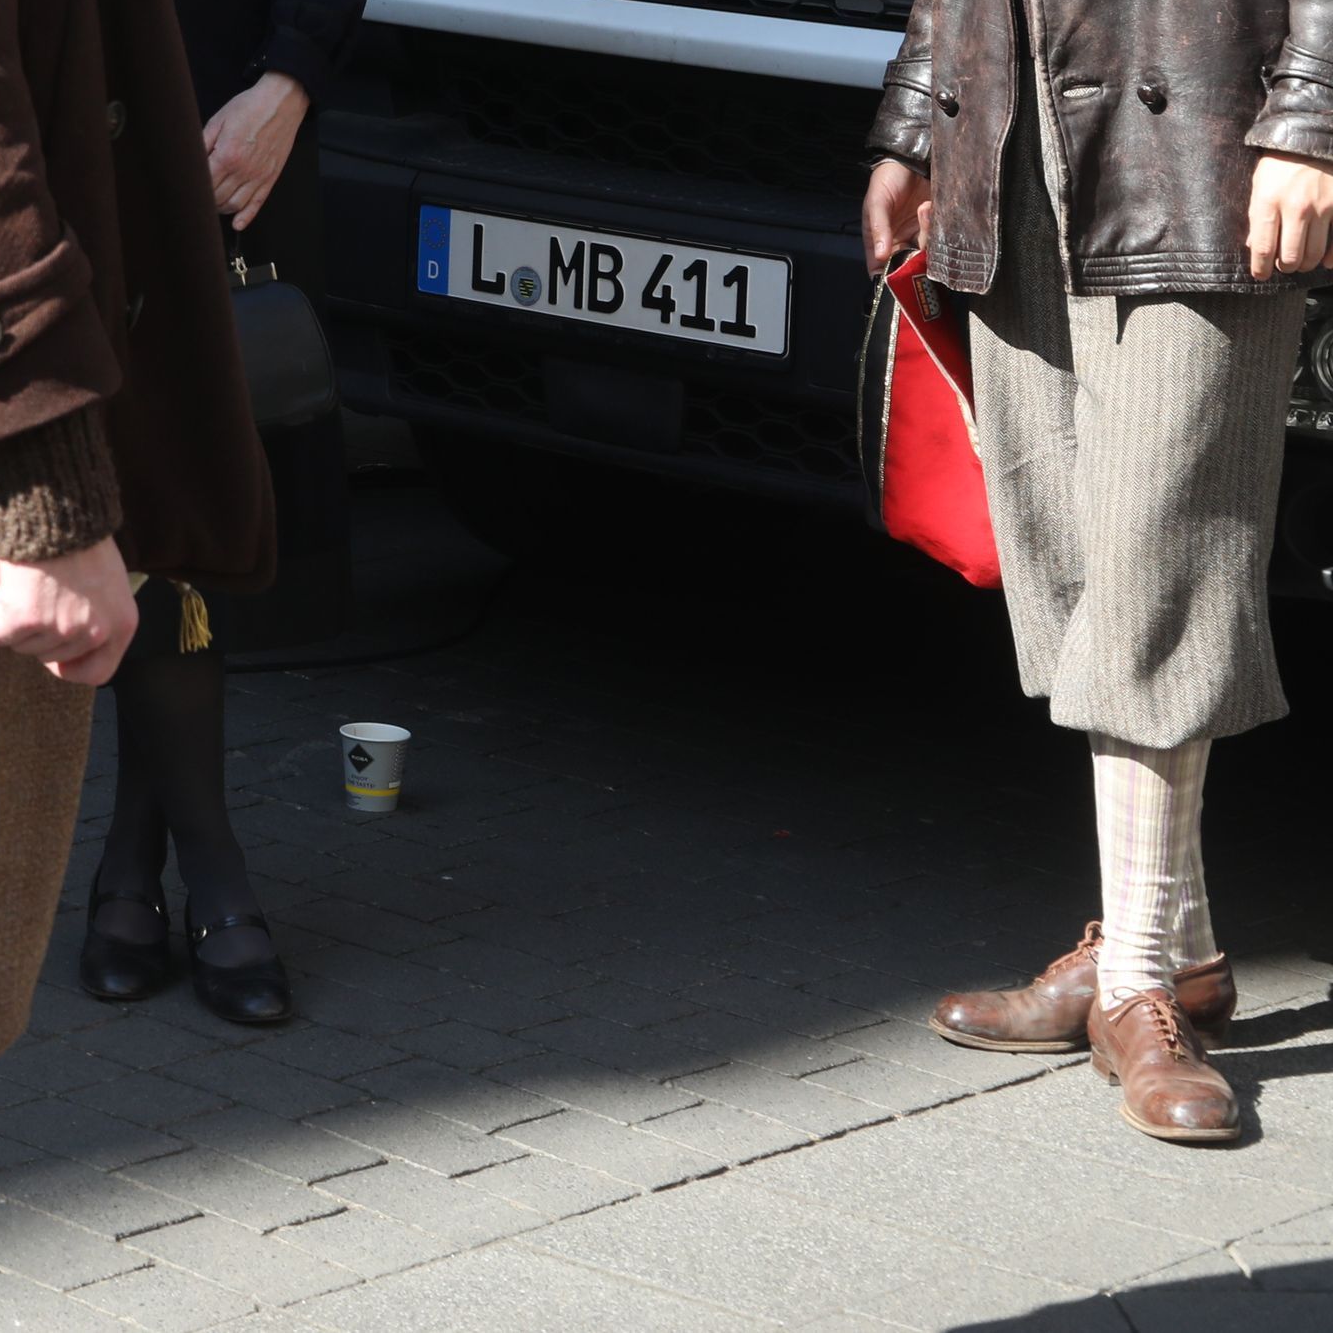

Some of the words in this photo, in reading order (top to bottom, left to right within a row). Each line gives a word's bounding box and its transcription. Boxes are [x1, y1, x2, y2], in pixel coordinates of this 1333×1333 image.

[427, 259, 439, 279] D
[471, 223, 506, 295] L
[547, 235, 624, 314] MB
[641, 252, 757, 338] 411
